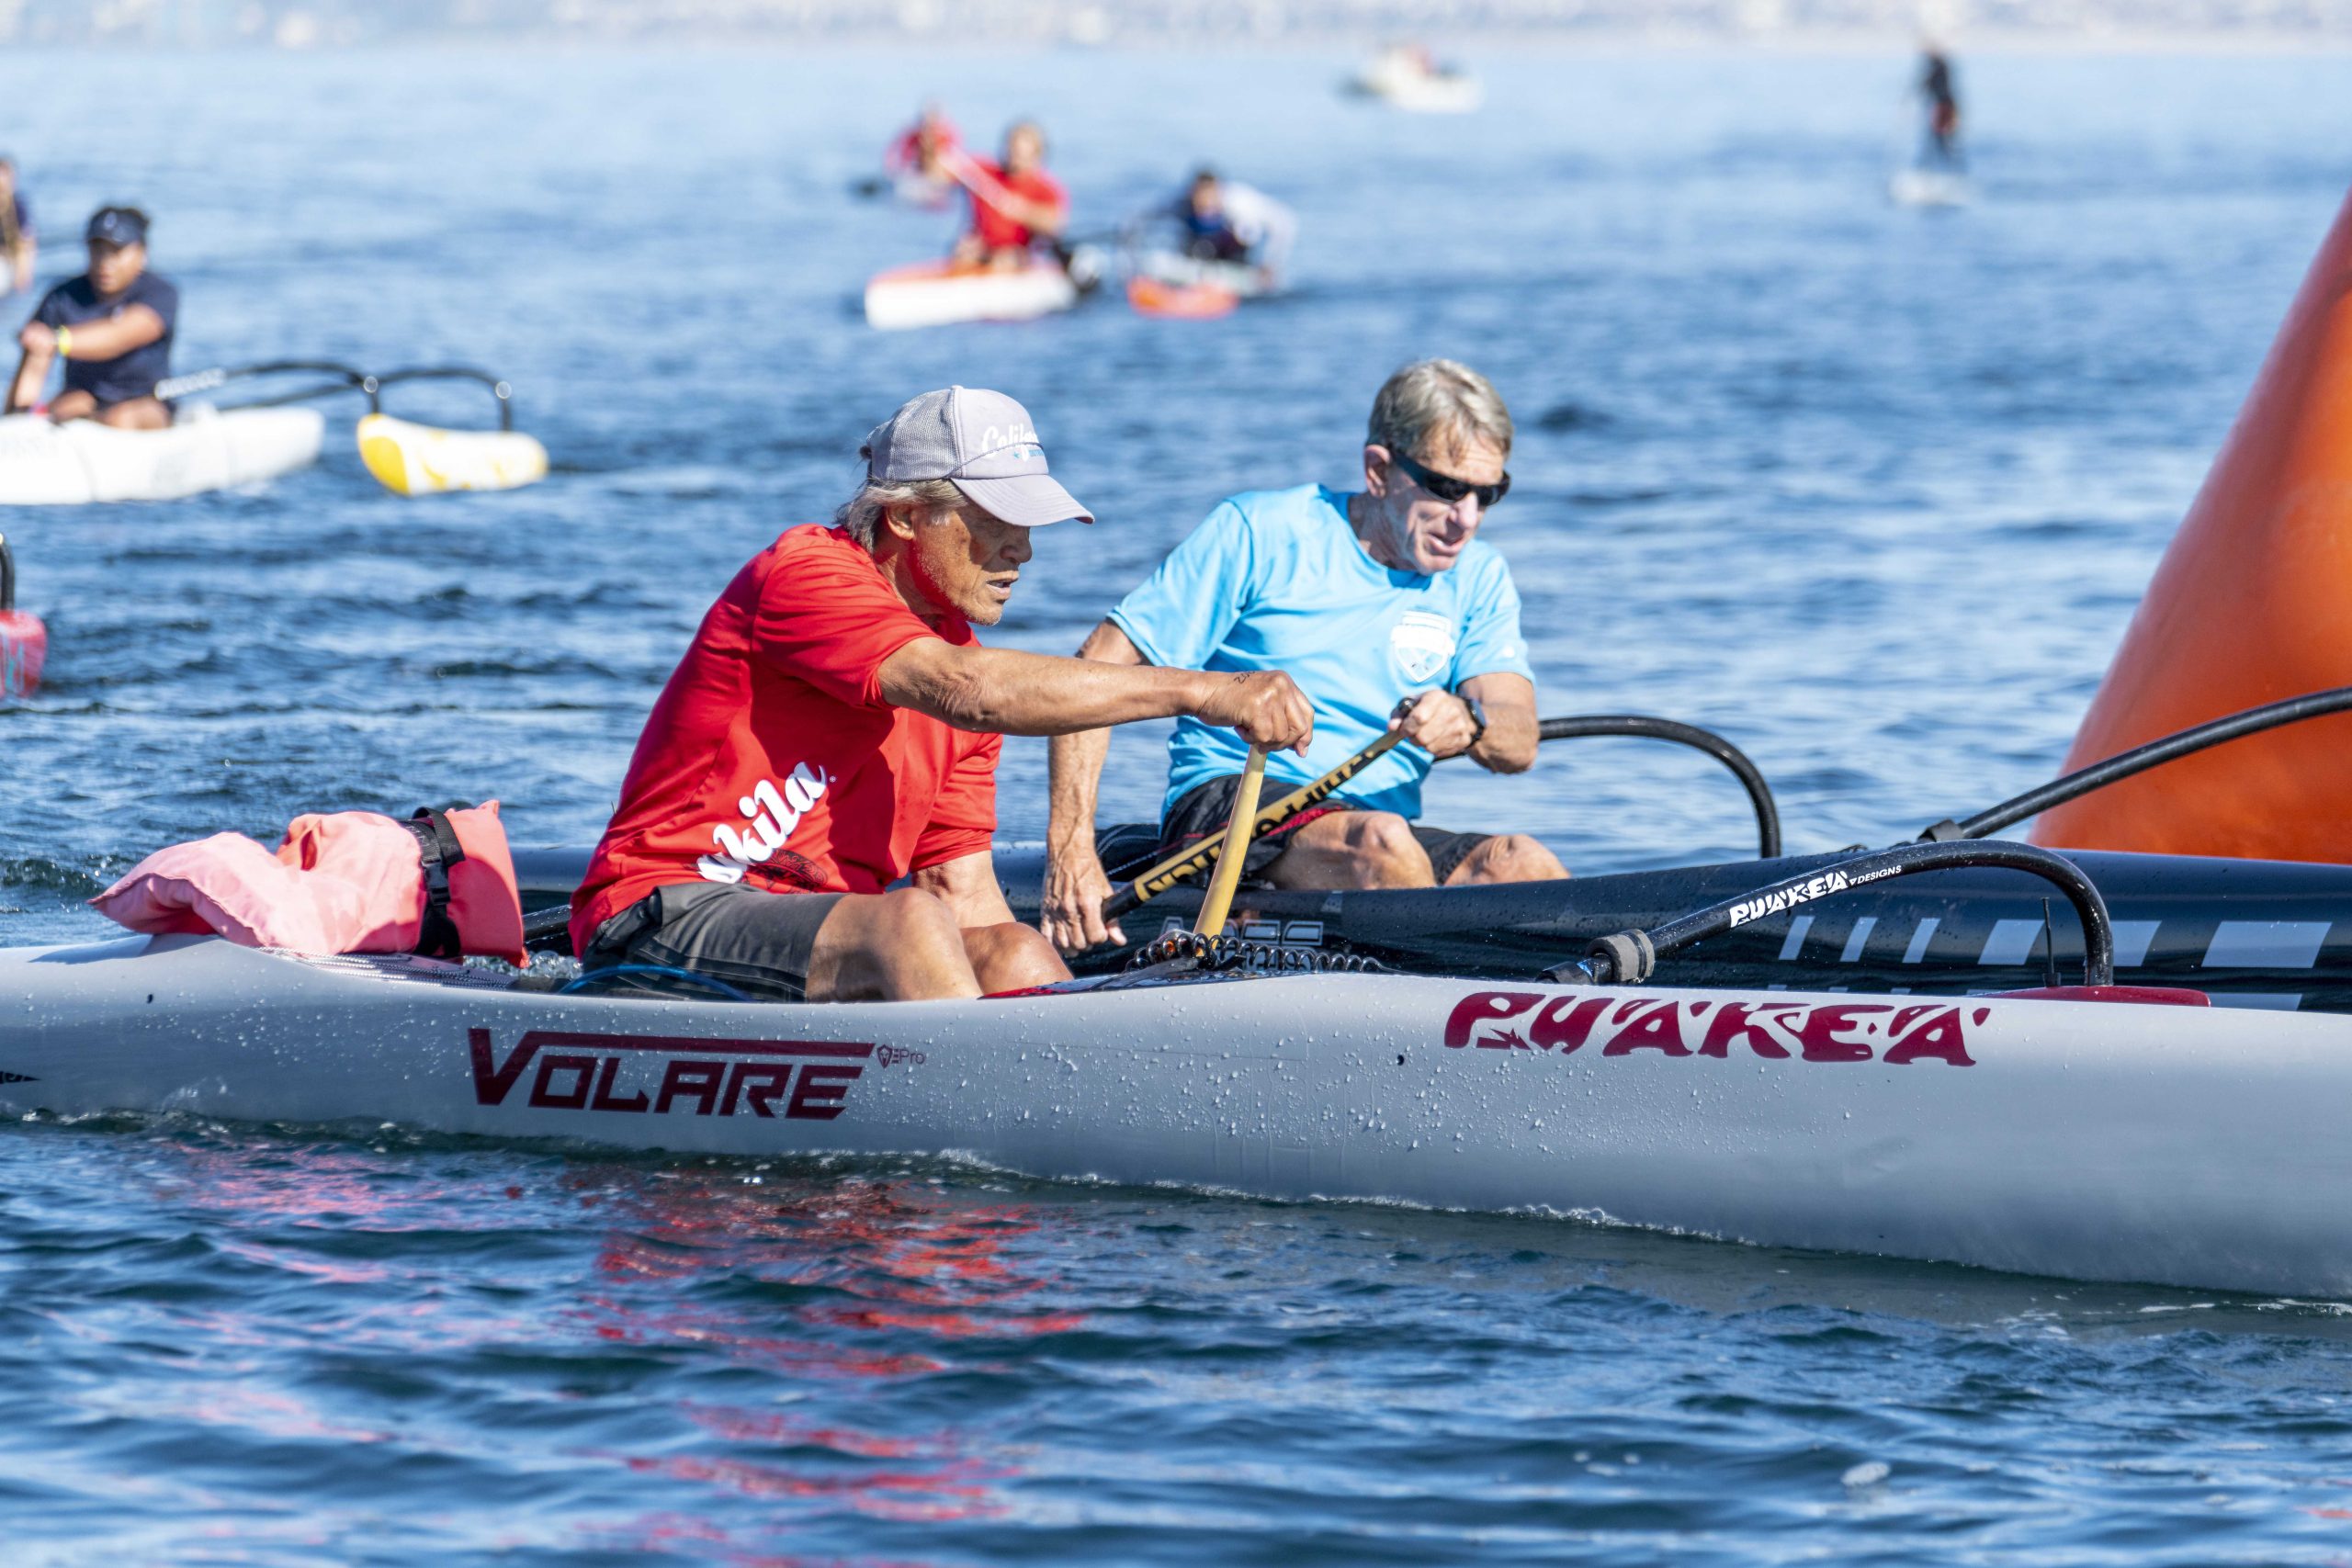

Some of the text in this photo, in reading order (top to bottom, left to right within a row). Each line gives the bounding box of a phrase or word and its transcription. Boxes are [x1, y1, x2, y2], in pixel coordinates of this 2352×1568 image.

[1729, 864, 1902, 928] PUAKEA DESIGNS
[1444, 991, 1991, 1066] PUAKEA
[467, 1028, 876, 1120] VOLARE
